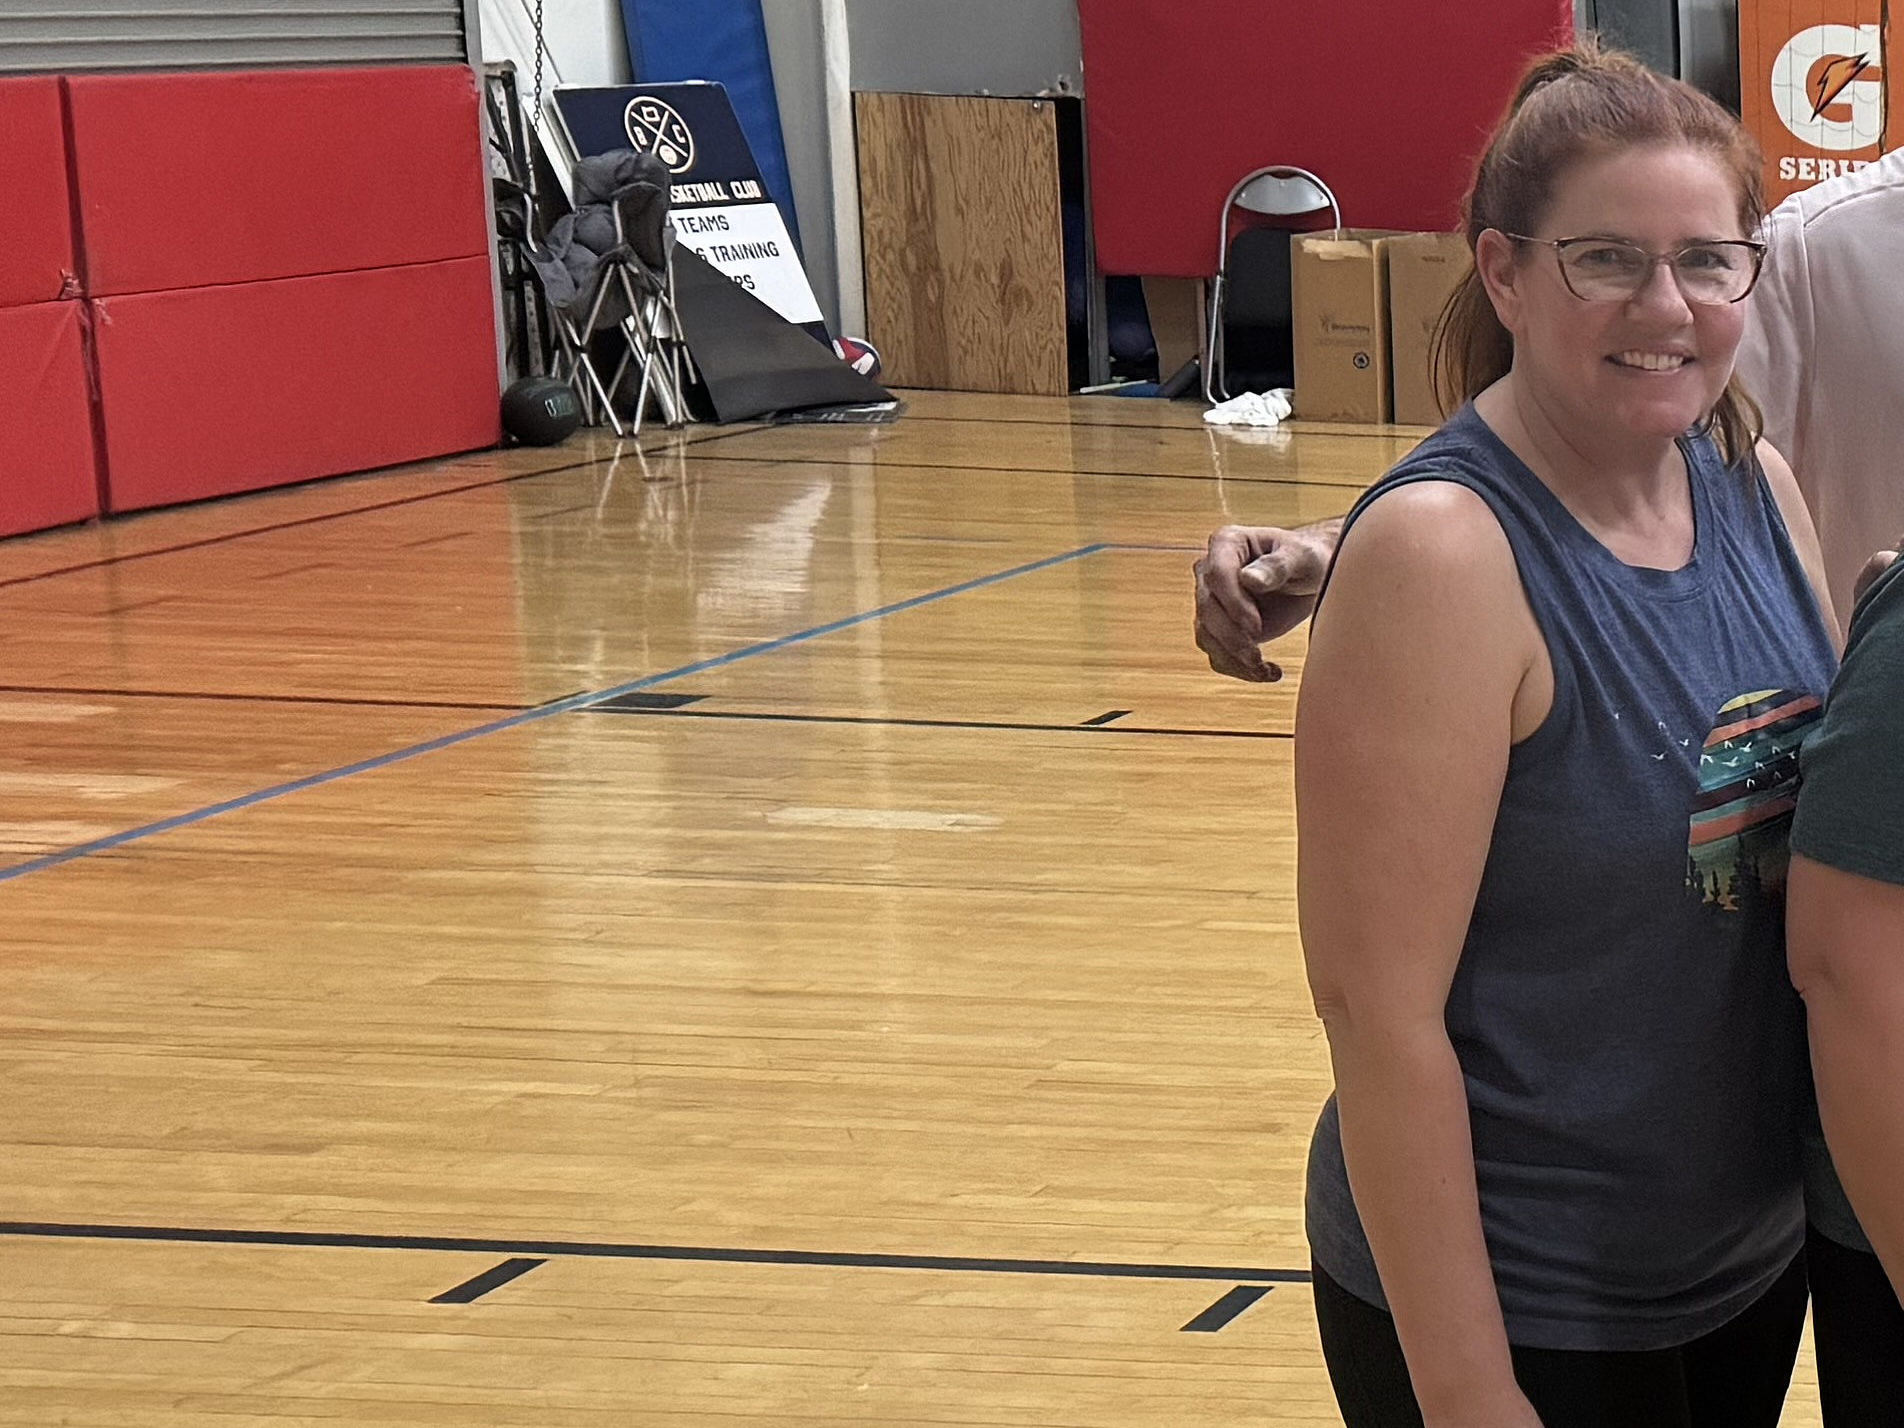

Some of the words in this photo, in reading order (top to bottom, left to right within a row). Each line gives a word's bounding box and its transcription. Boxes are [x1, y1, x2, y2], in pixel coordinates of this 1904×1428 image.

[1770, 23, 1881, 151] G
[670, 181, 731, 204] SKETBALL
[677, 214, 731, 234] TEAMS
[709, 241, 780, 263] TRAINING
